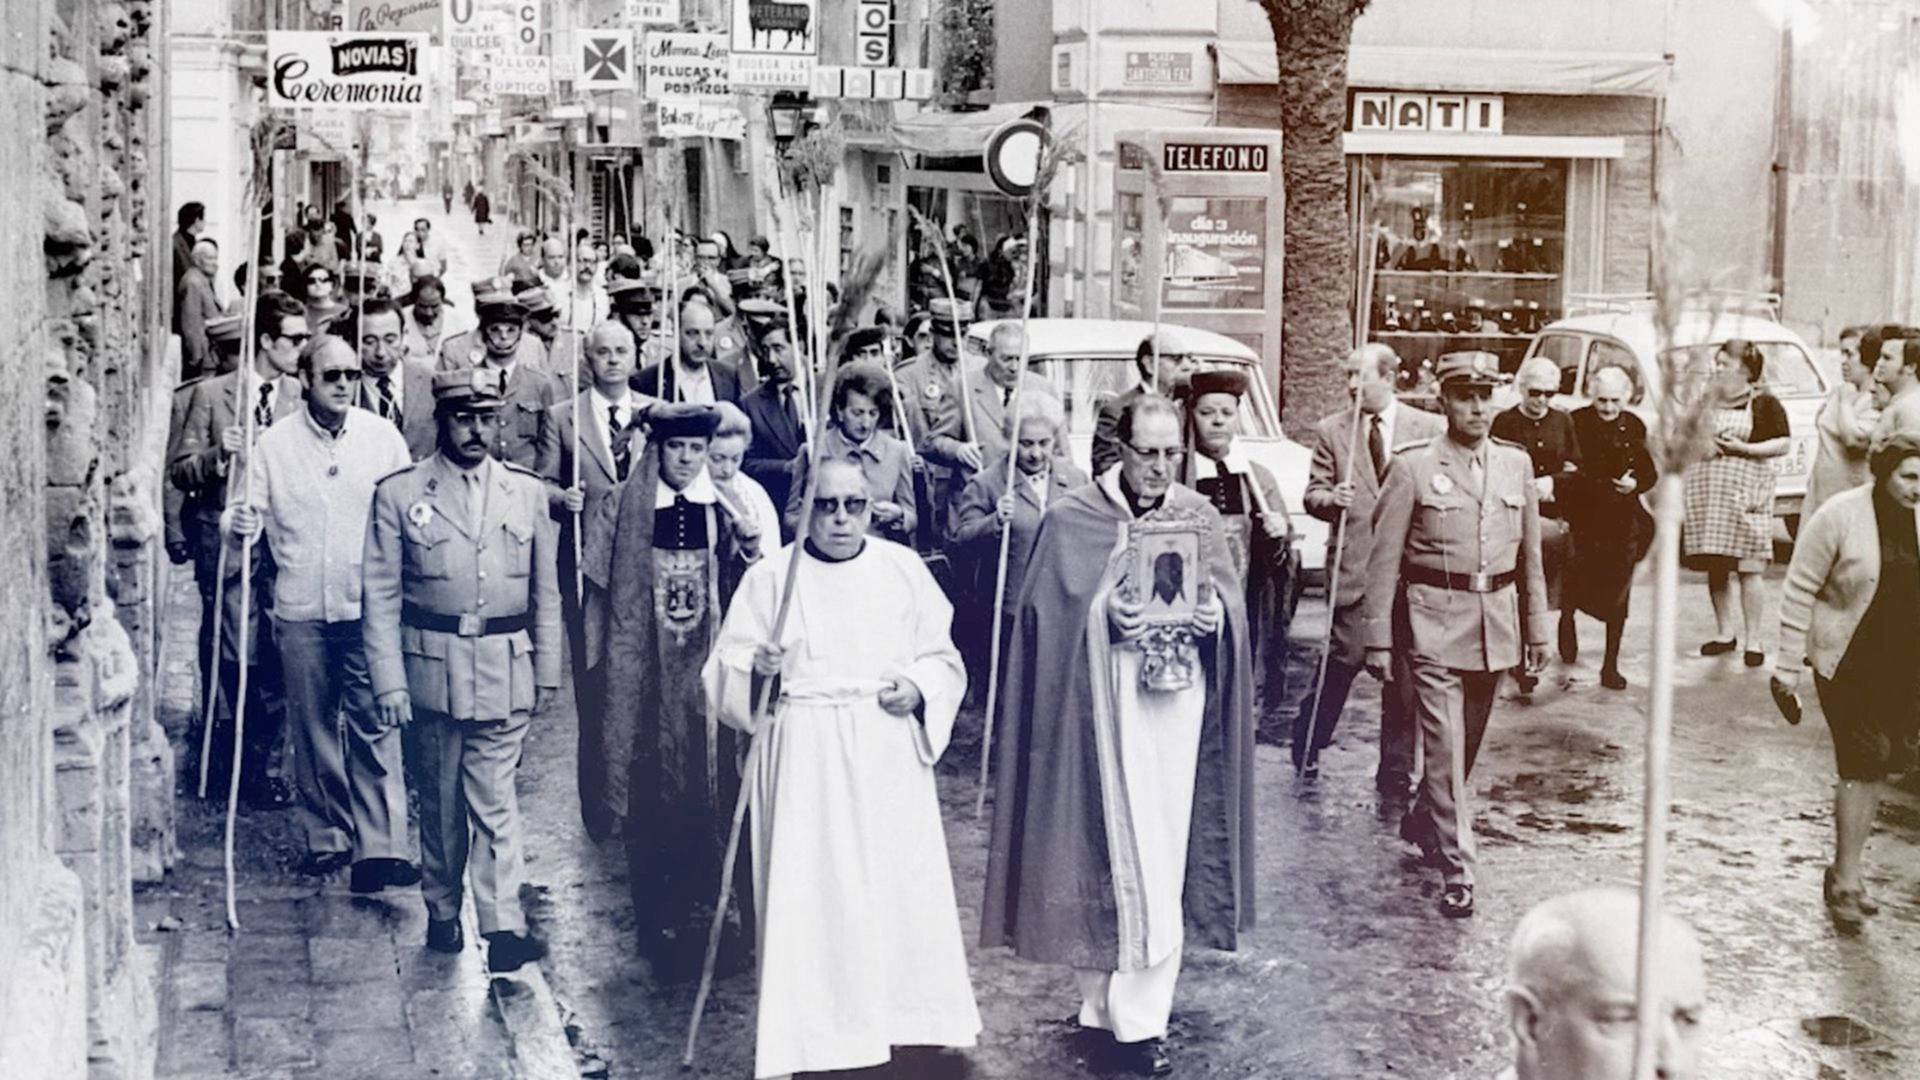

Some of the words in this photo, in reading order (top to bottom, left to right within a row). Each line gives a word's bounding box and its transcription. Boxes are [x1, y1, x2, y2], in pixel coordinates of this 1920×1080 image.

[338, 46, 404, 69] NOVIAS
[494, 58, 547, 68] ULLOA
[274, 53, 422, 103] Ceremonia
[650, 65, 711, 78] PELUCAS
[817, 72, 925, 96] NATI
[1361, 100, 1491, 127] NATI
[1166, 145, 1265, 170] TELEFONO
[1215, 219, 1228, 231] 3
[1167, 229, 1258, 247] inauguración
